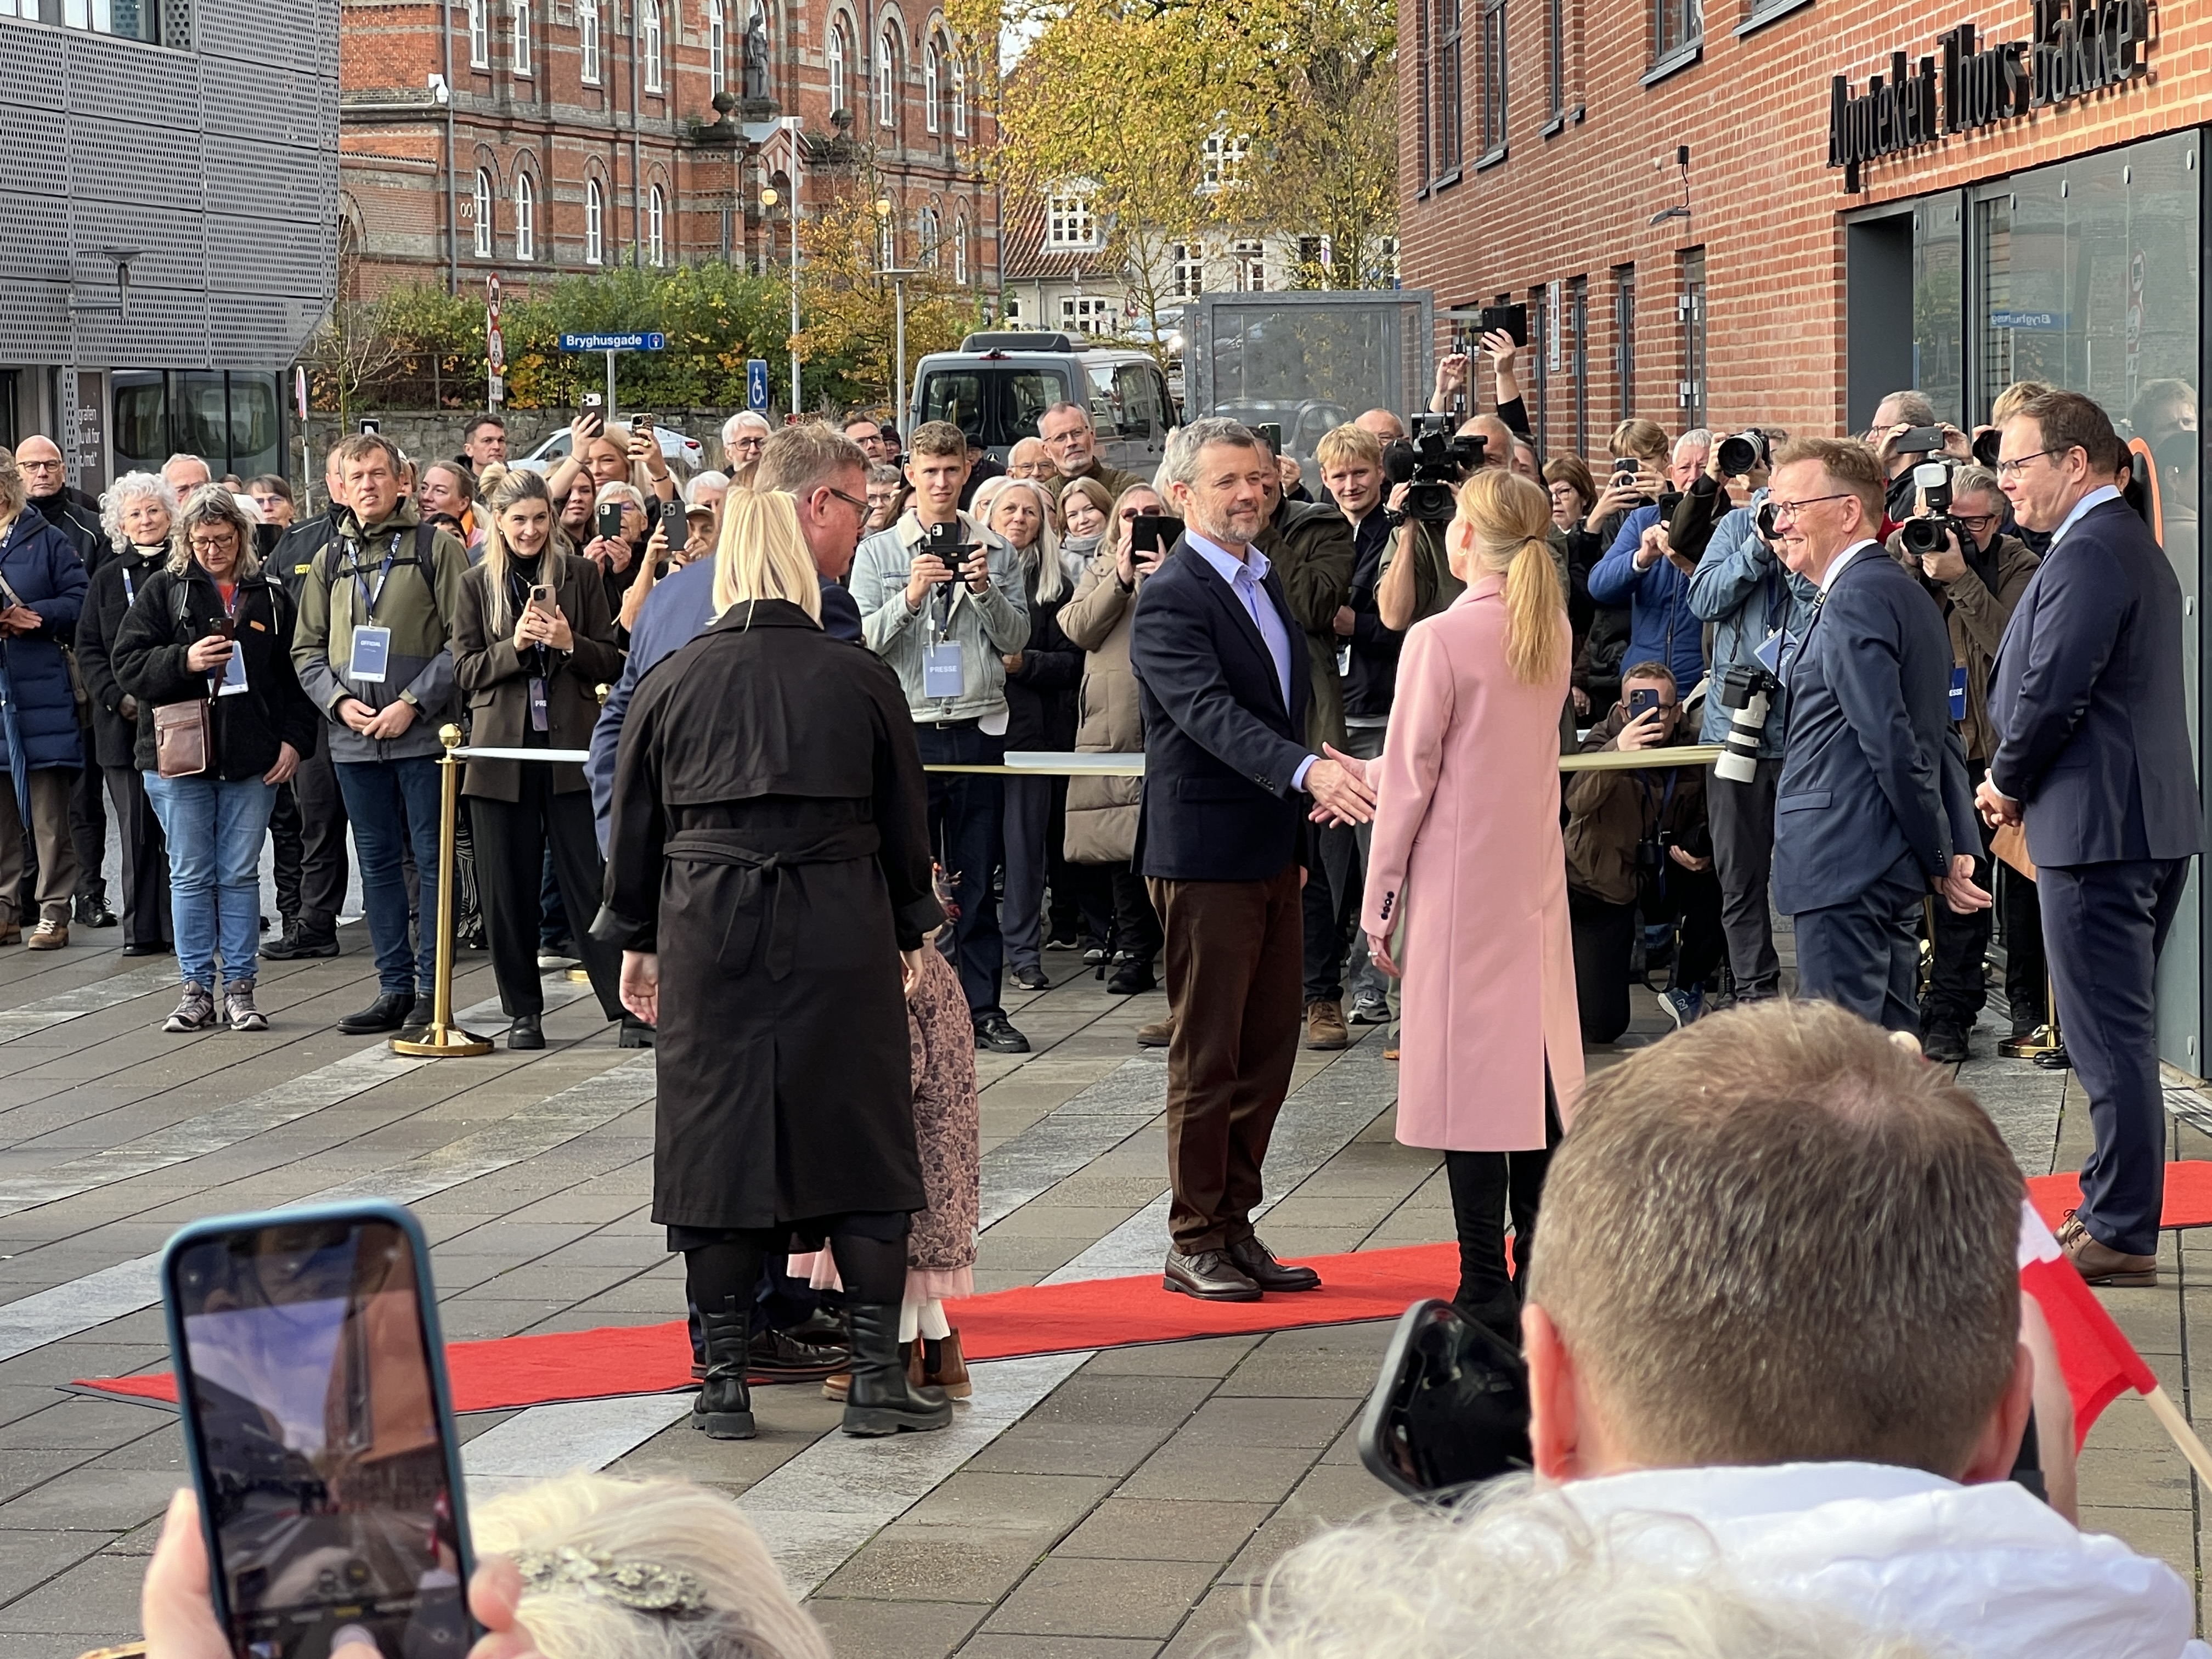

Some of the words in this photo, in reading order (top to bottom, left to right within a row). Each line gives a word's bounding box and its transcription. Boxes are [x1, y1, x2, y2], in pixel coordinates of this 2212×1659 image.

[1827, 51, 1939, 194] Apoteket
[1937, 24, 2029, 136] Thors
[2030, 0, 2148, 109] Bakke
[566, 335, 642, 348] Bryghusgade
[929, 665, 957, 673] PRESSE
